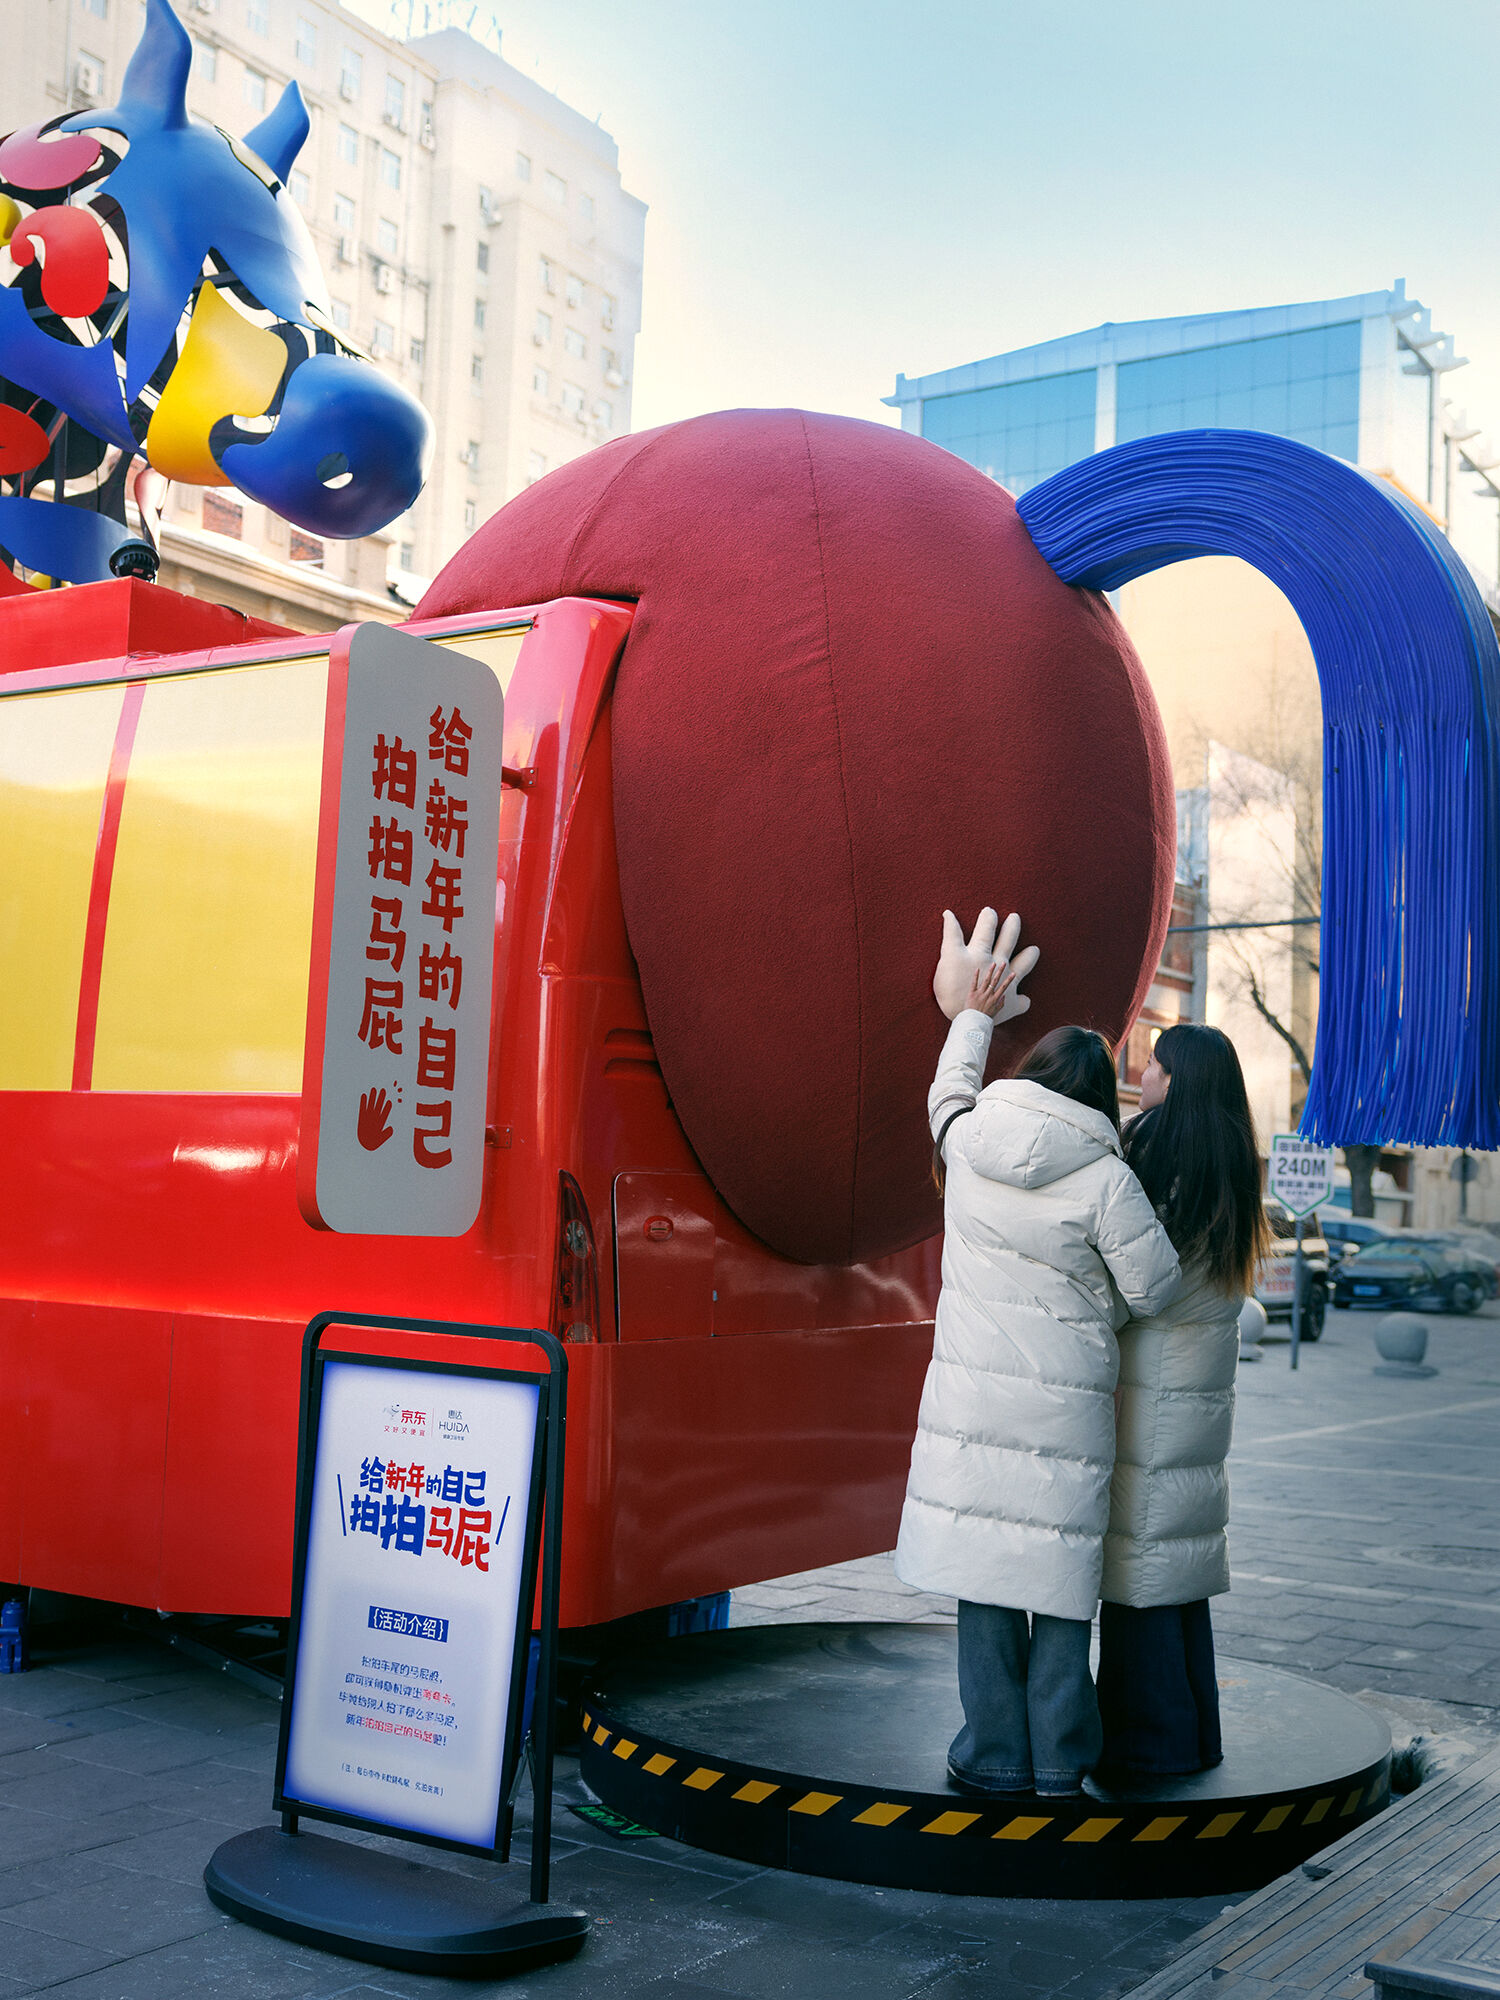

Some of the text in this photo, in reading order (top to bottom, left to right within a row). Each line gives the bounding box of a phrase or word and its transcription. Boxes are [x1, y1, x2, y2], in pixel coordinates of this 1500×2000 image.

[358, 733, 417, 1056] 拍拍马屁
[413, 705, 473, 1169] 给新年的自己
[1277, 1157, 1326, 1177] 240M
[400, 1410, 427, 1425] 京东
[438, 1421, 470, 1433] HUIDA
[359, 1456, 487, 1507] 给新年的自己
[349, 1493, 492, 1573] 拍拍马屁
